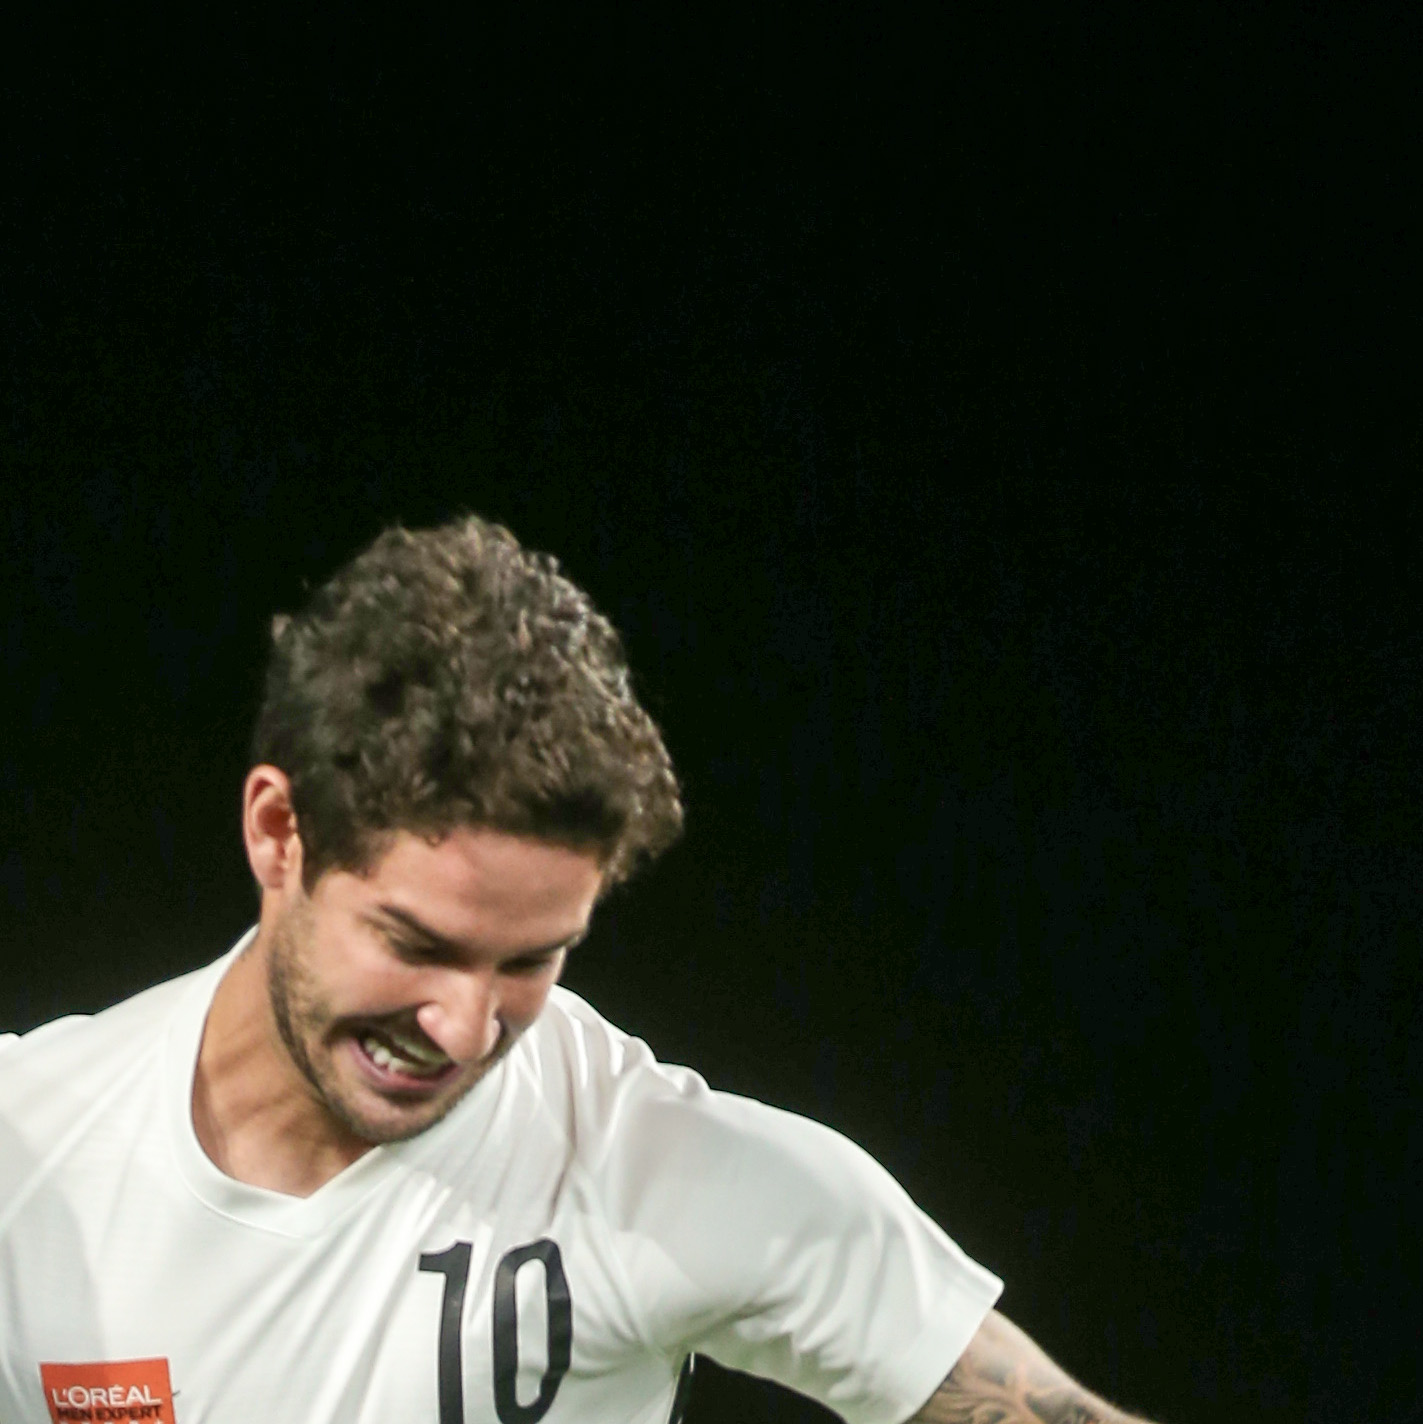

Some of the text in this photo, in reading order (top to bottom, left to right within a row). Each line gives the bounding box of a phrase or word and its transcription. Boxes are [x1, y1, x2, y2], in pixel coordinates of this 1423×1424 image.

[52, 1384, 163, 1409] L'ORÉAL
[57, 1405, 162, 1421] MEN EXPERT
